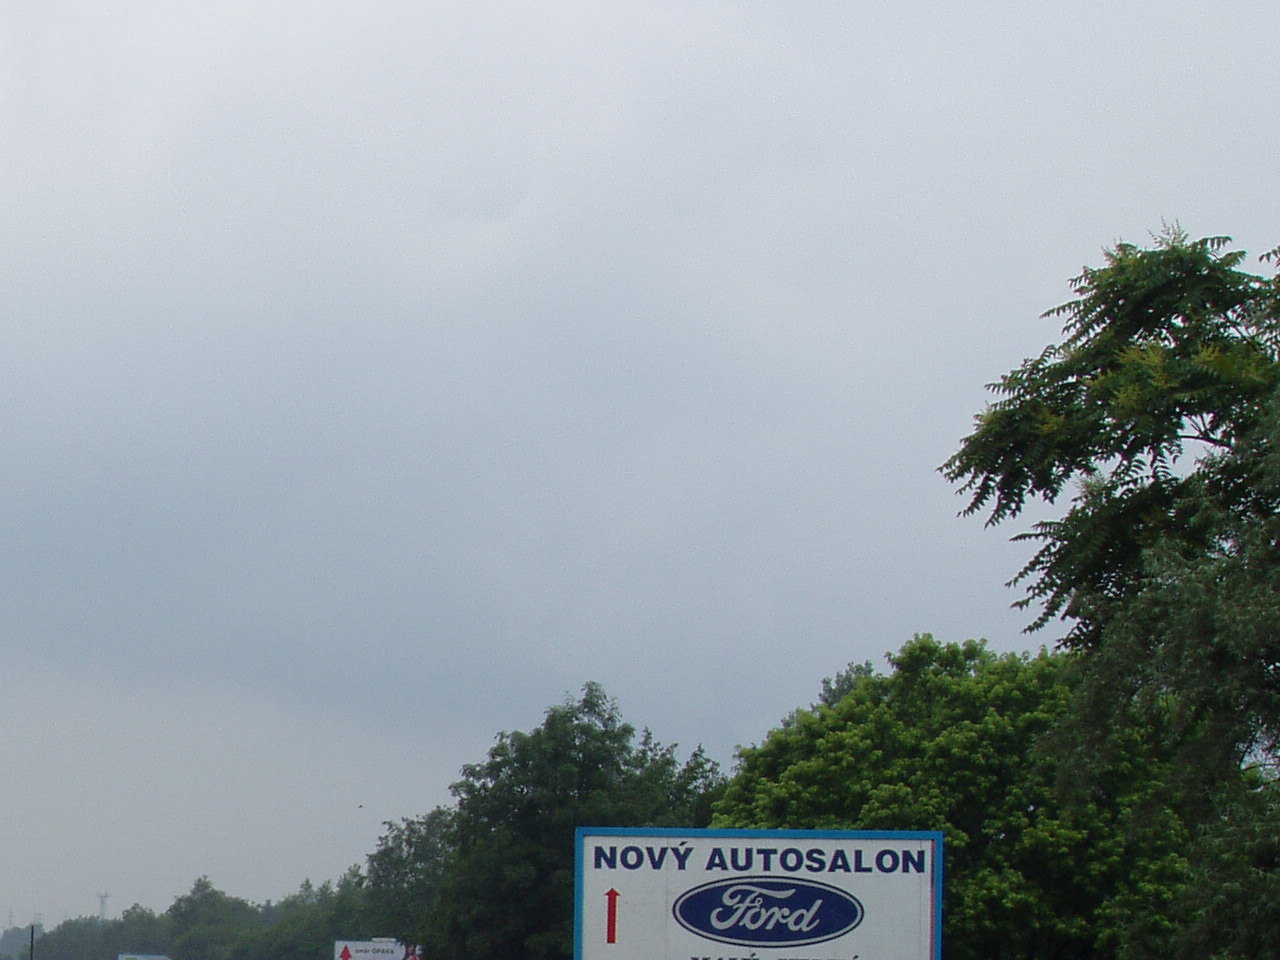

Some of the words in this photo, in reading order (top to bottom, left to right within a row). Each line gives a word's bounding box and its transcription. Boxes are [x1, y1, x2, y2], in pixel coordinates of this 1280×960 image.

[594, 841, 694, 870] NOVÝ
[705, 847, 925, 873] AUTOSALON
[710, 884, 822, 932] Ford
